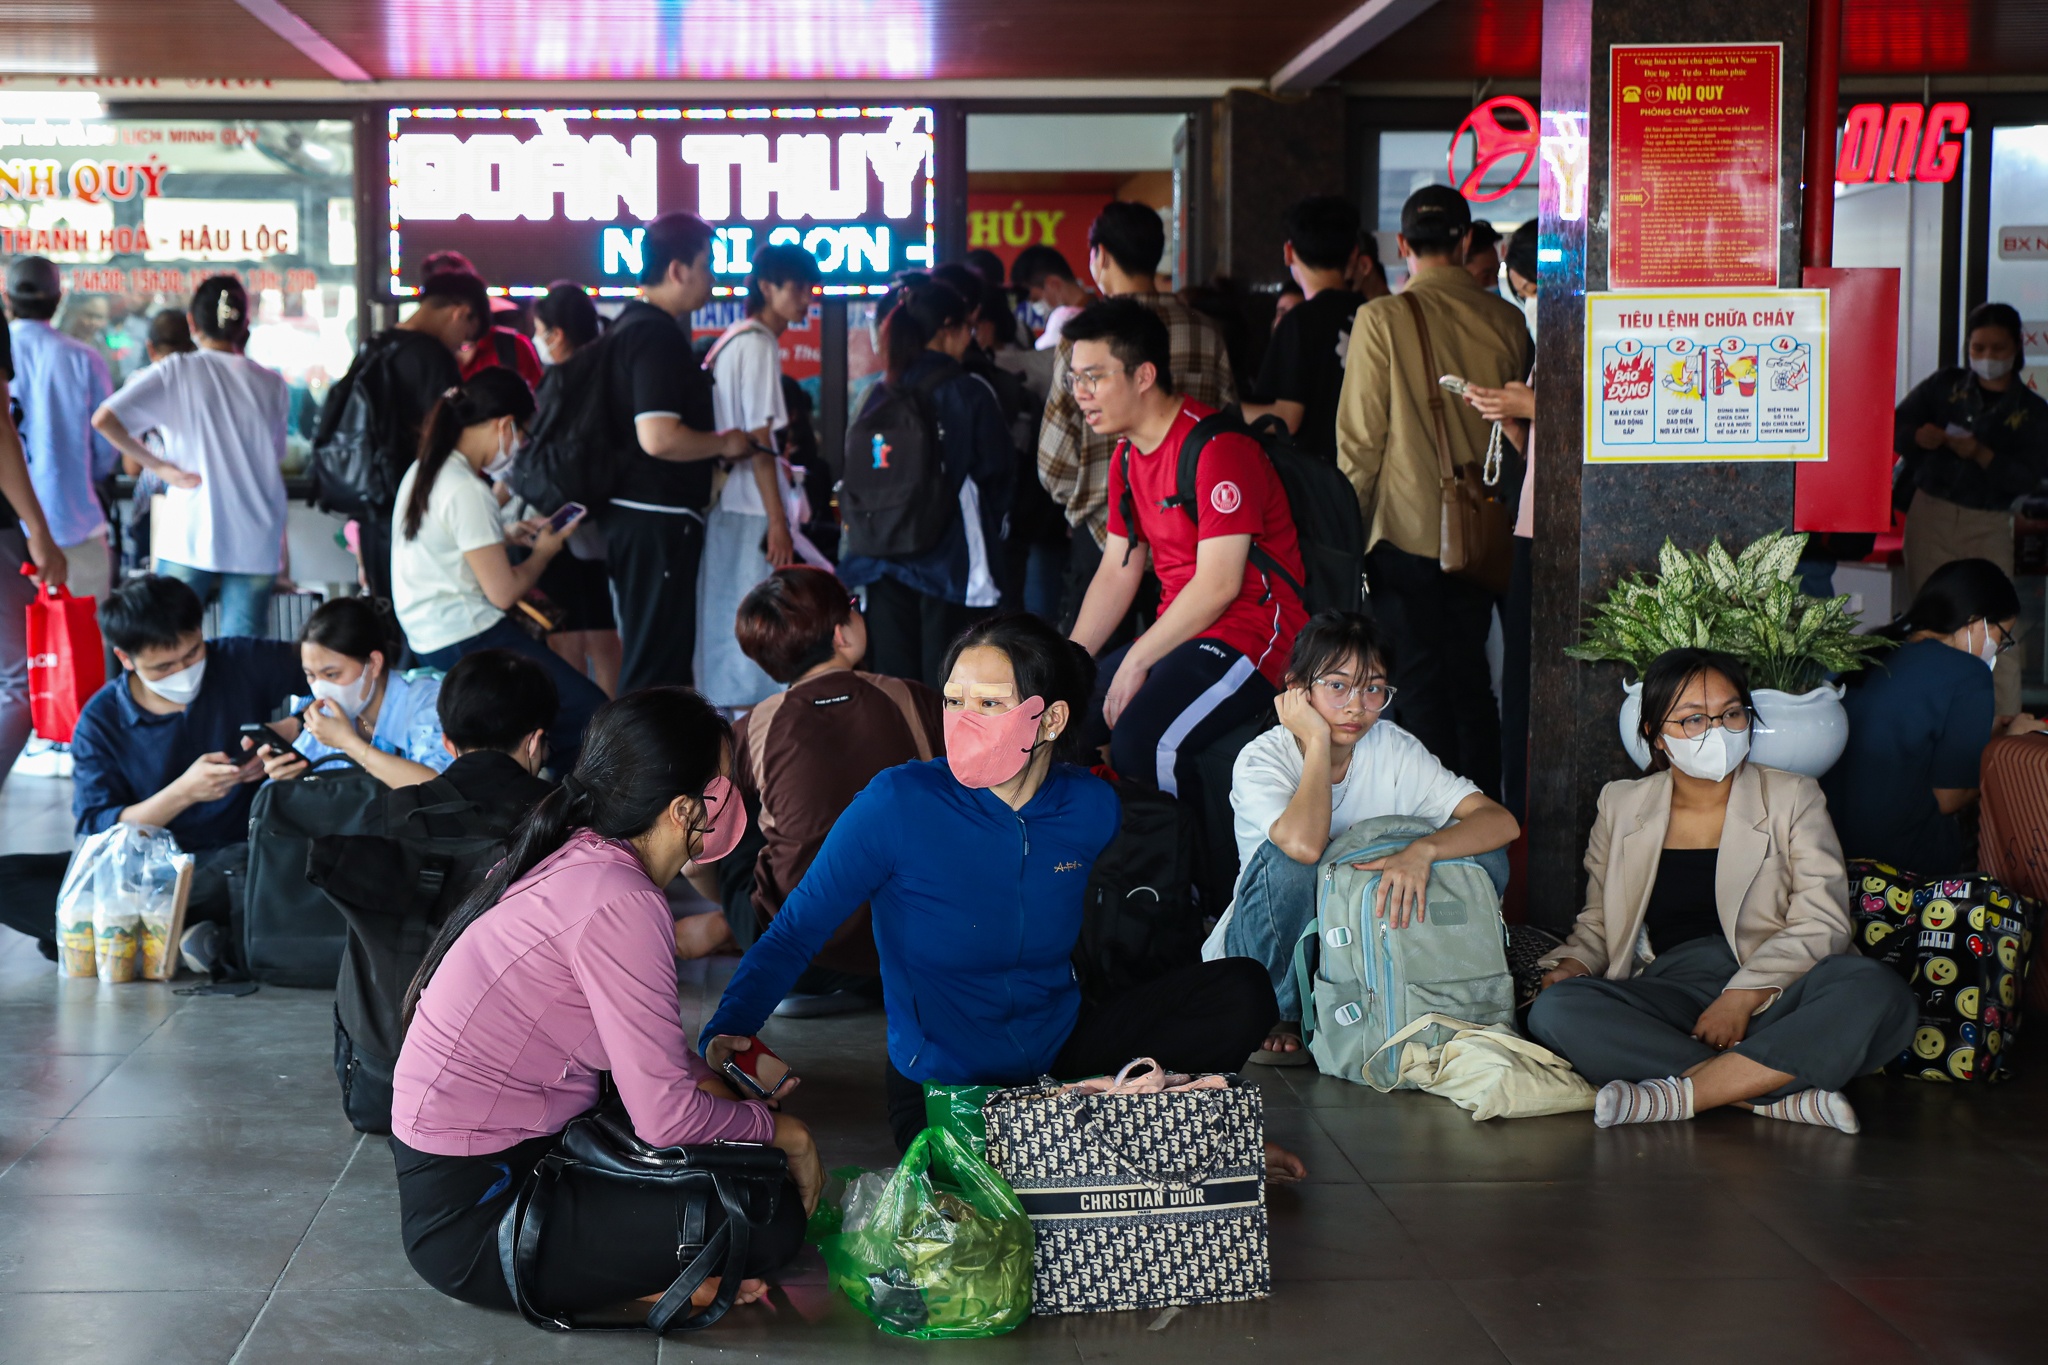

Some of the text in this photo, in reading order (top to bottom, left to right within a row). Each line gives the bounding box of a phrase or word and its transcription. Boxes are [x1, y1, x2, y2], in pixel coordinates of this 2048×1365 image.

[1666, 83, 1692, 104] NỘI
[1696, 84, 1724, 102] QUY
[1640, 105, 1750, 116] PHÒNG CHÁY CHỮA CHÁY
[74, 153, 168, 204] QUÝ
[1, 229, 88, 252] THANH
[1619, 308, 1795, 332] TIÊU LỆNH CHỮA CHÁY
[1625, 341, 1632, 352] 1
[1676, 340, 1685, 351] 2
[1728, 339, 1737, 351] 3
[1779, 339, 1789, 350] 4
[1613, 368, 1640, 382] BÁO
[1608, 380, 1649, 402] ĐỘNG
[1080, 1187, 1205, 1211] CHRISTIAN DIOR
